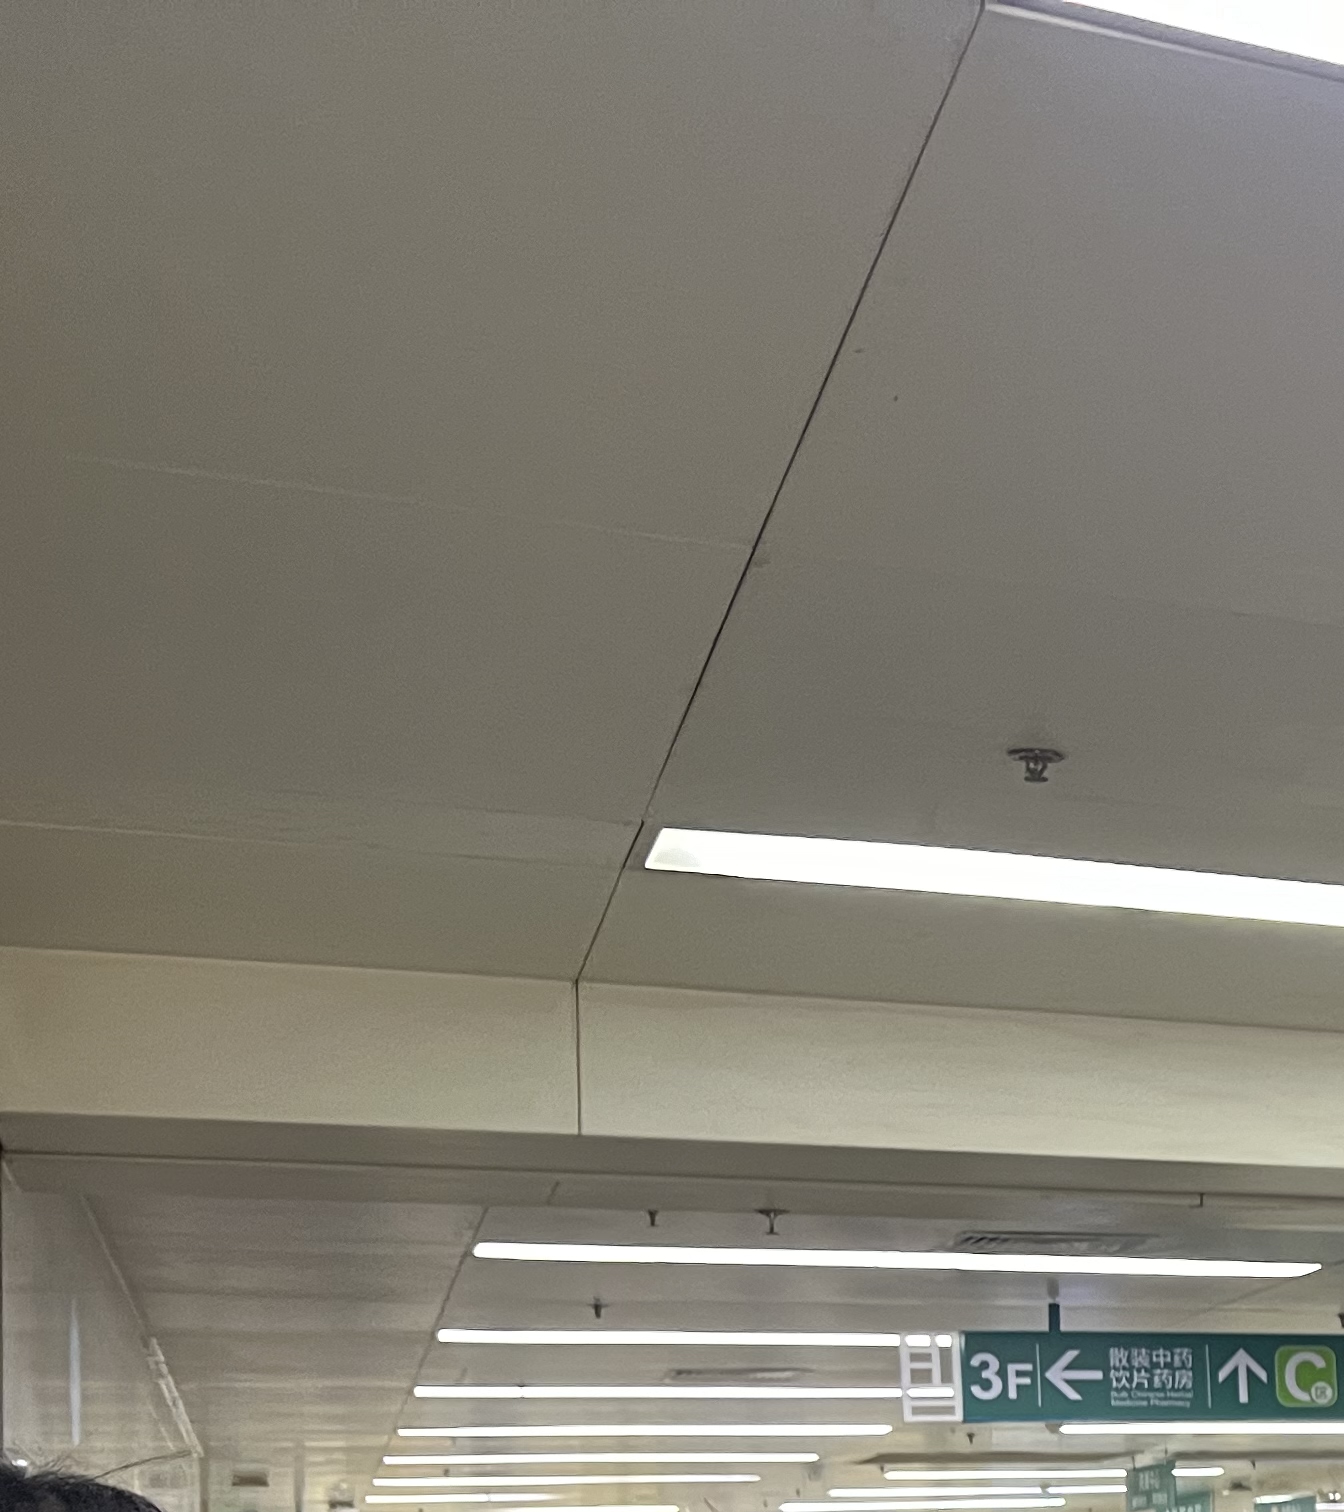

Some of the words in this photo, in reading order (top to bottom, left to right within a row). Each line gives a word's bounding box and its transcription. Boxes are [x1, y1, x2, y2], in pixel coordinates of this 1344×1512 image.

[970, 1352, 1033, 1400] 3F
[1110, 1369, 1193, 1389] 饮片药房
